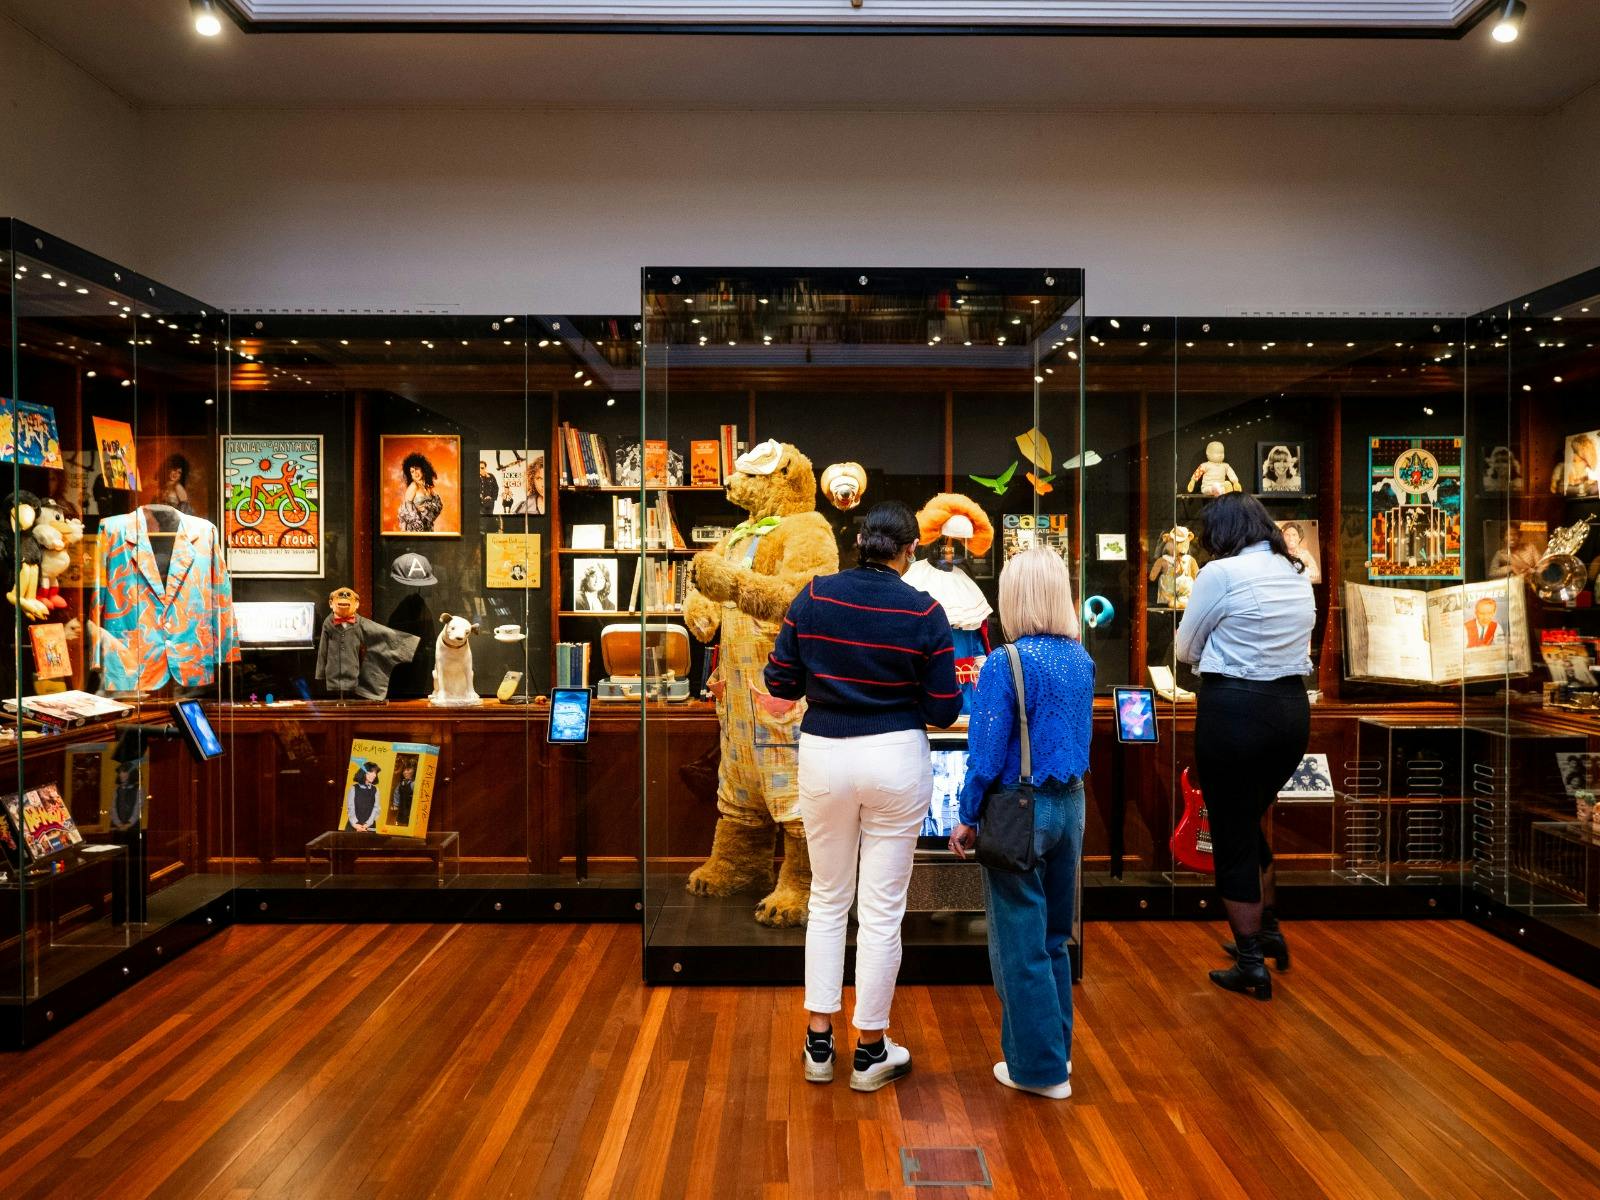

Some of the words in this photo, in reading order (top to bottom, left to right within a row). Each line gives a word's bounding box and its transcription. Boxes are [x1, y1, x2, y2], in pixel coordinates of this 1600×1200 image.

[272, 440, 318, 452] ANYTHING
[284, 534, 316, 545] TOUR
[408, 558, 427, 577] A
